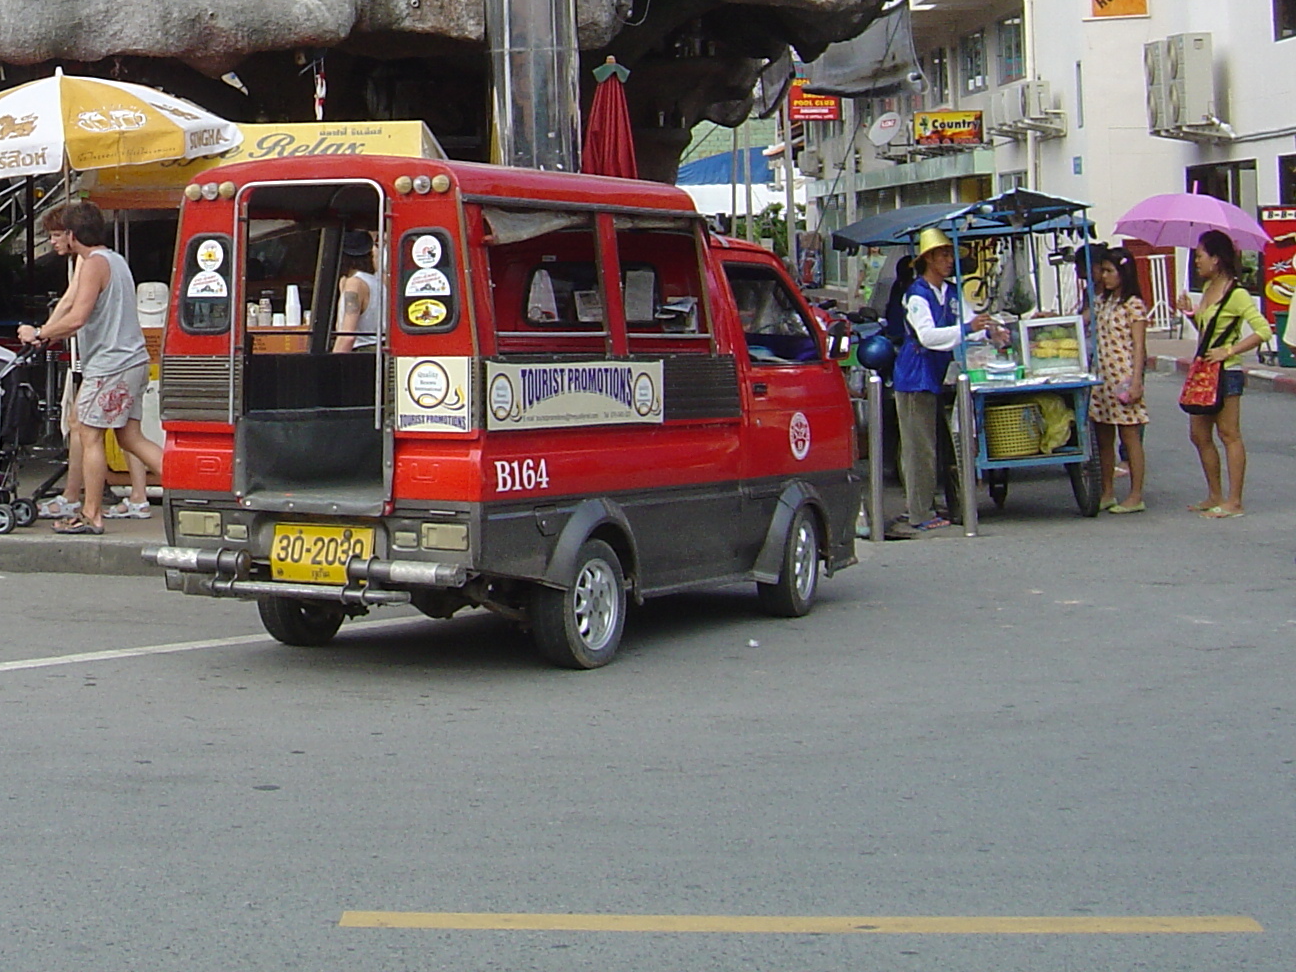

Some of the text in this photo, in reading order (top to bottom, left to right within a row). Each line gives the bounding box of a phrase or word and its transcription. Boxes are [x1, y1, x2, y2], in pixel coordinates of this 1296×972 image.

[793, 99, 835, 107] POOL CLUB
[932, 119, 980, 131] Country
[188, 128, 230, 150] SINGHA
[248, 132, 366, 159] Relax
[417, 370, 439, 380] Quality
[520, 367, 567, 412] TOURIST
[567, 366, 634, 410] PROMOTIONS
[399, 414, 467, 430] TOURIST PROMOTIONS
[494, 458, 550, 493] B164
